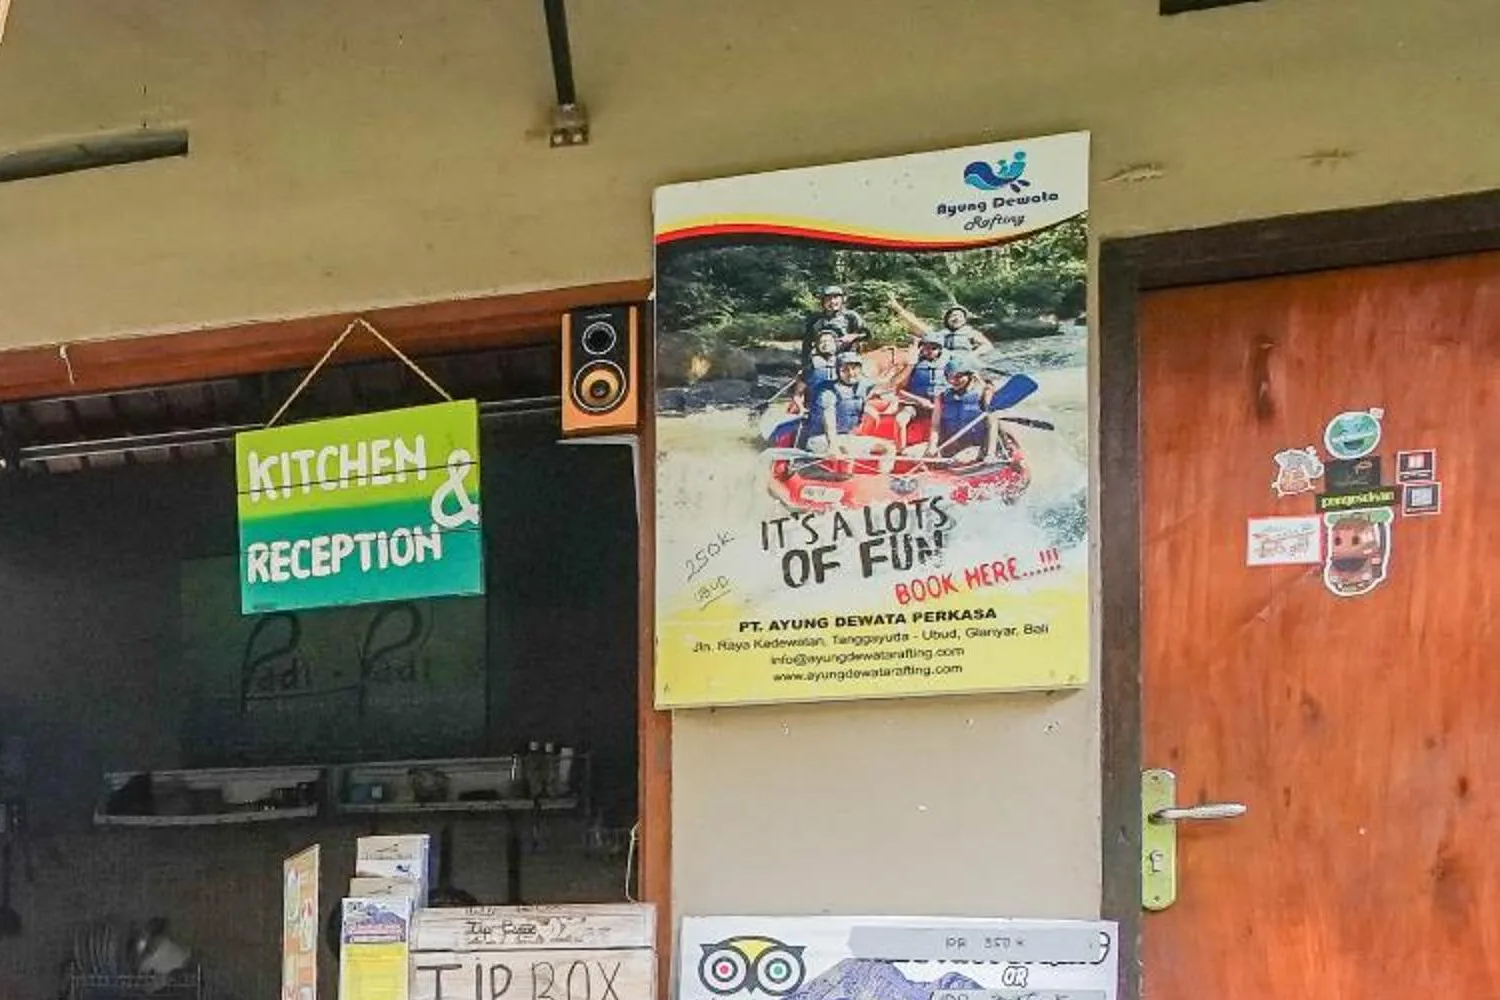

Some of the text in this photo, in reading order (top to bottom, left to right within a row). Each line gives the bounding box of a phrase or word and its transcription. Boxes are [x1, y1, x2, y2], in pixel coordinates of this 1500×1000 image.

[937, 192, 1058, 216] Ayung Dewata
[964, 214, 1026, 231] Rafting
[250, 434, 480, 530] KITCHEN &
[761, 495, 948, 551] IT'S A LOTS
[247, 523, 442, 584] RECEPTION
[781, 544, 841, 589] OF
[859, 529, 944, 579] FUN
[894, 572, 959, 605] BOOK
[739, 607, 998, 633] PT. AYUNG DEWATA PERKASA
[717, 640, 752, 653] Raya
[921, 628, 961, 642] Ubud,
[1023, 623, 1050, 637] Bali
[1003, 964, 1028, 988] OR
